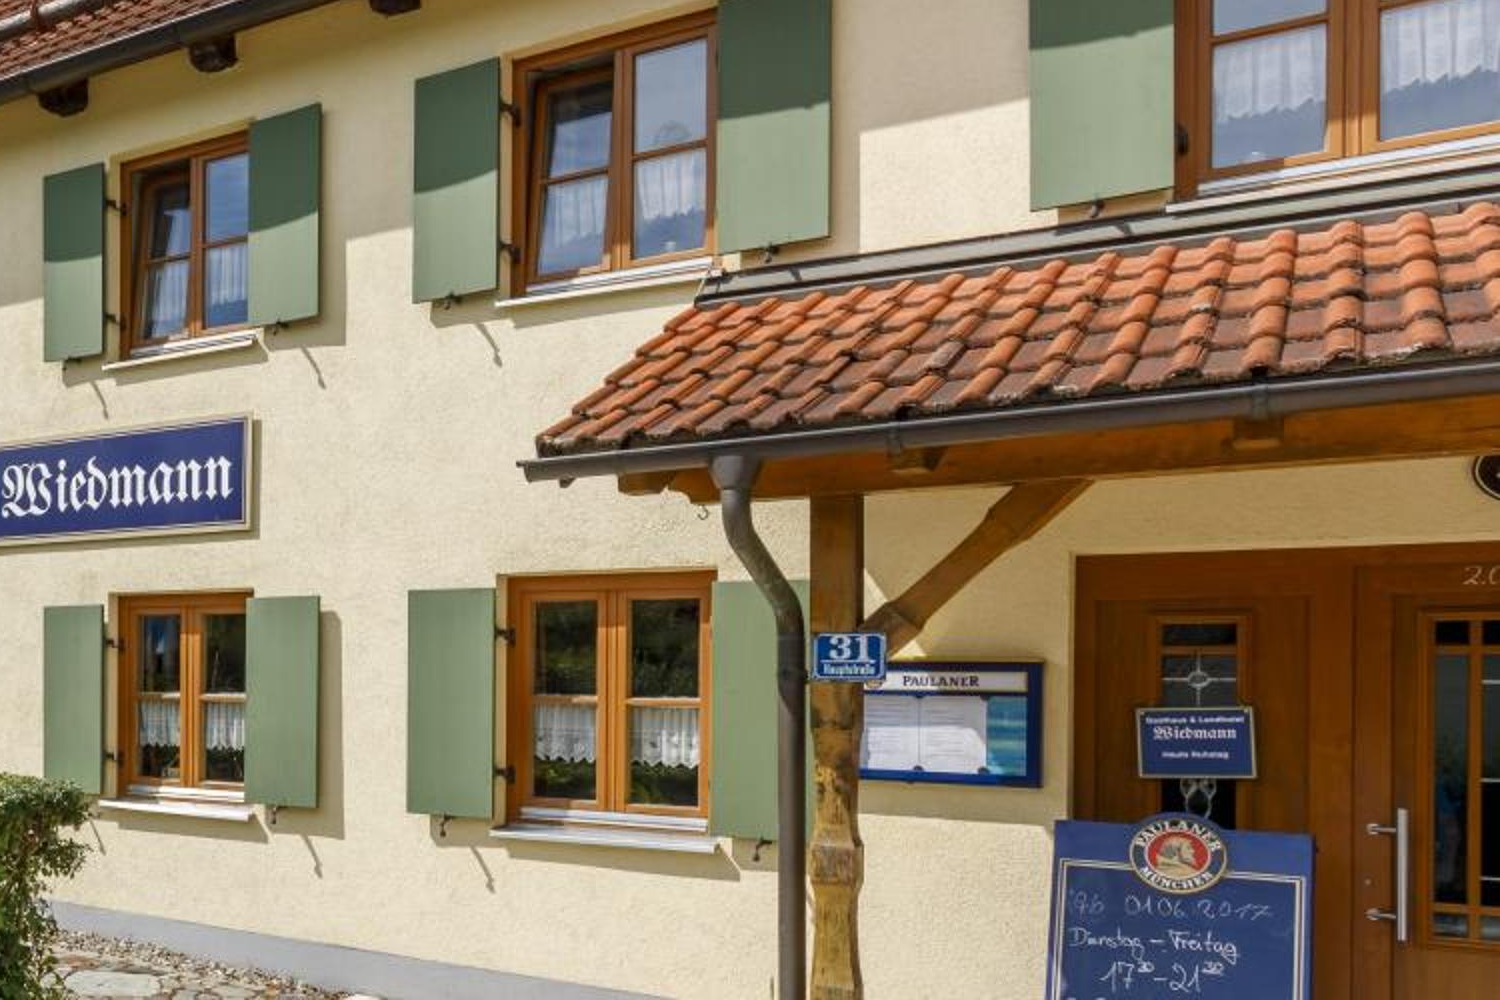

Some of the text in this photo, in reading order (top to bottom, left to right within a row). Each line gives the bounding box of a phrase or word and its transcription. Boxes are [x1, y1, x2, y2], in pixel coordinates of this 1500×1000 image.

[1, 456, 234, 518] Wiedmann
[828, 634, 871, 660] 31
[902, 675, 980, 687] PAULANER
[1153, 726, 1237, 740] Wiedmann
[1134, 820, 1221, 852] PAULANER
[1167, 928, 1239, 965] Freitag
